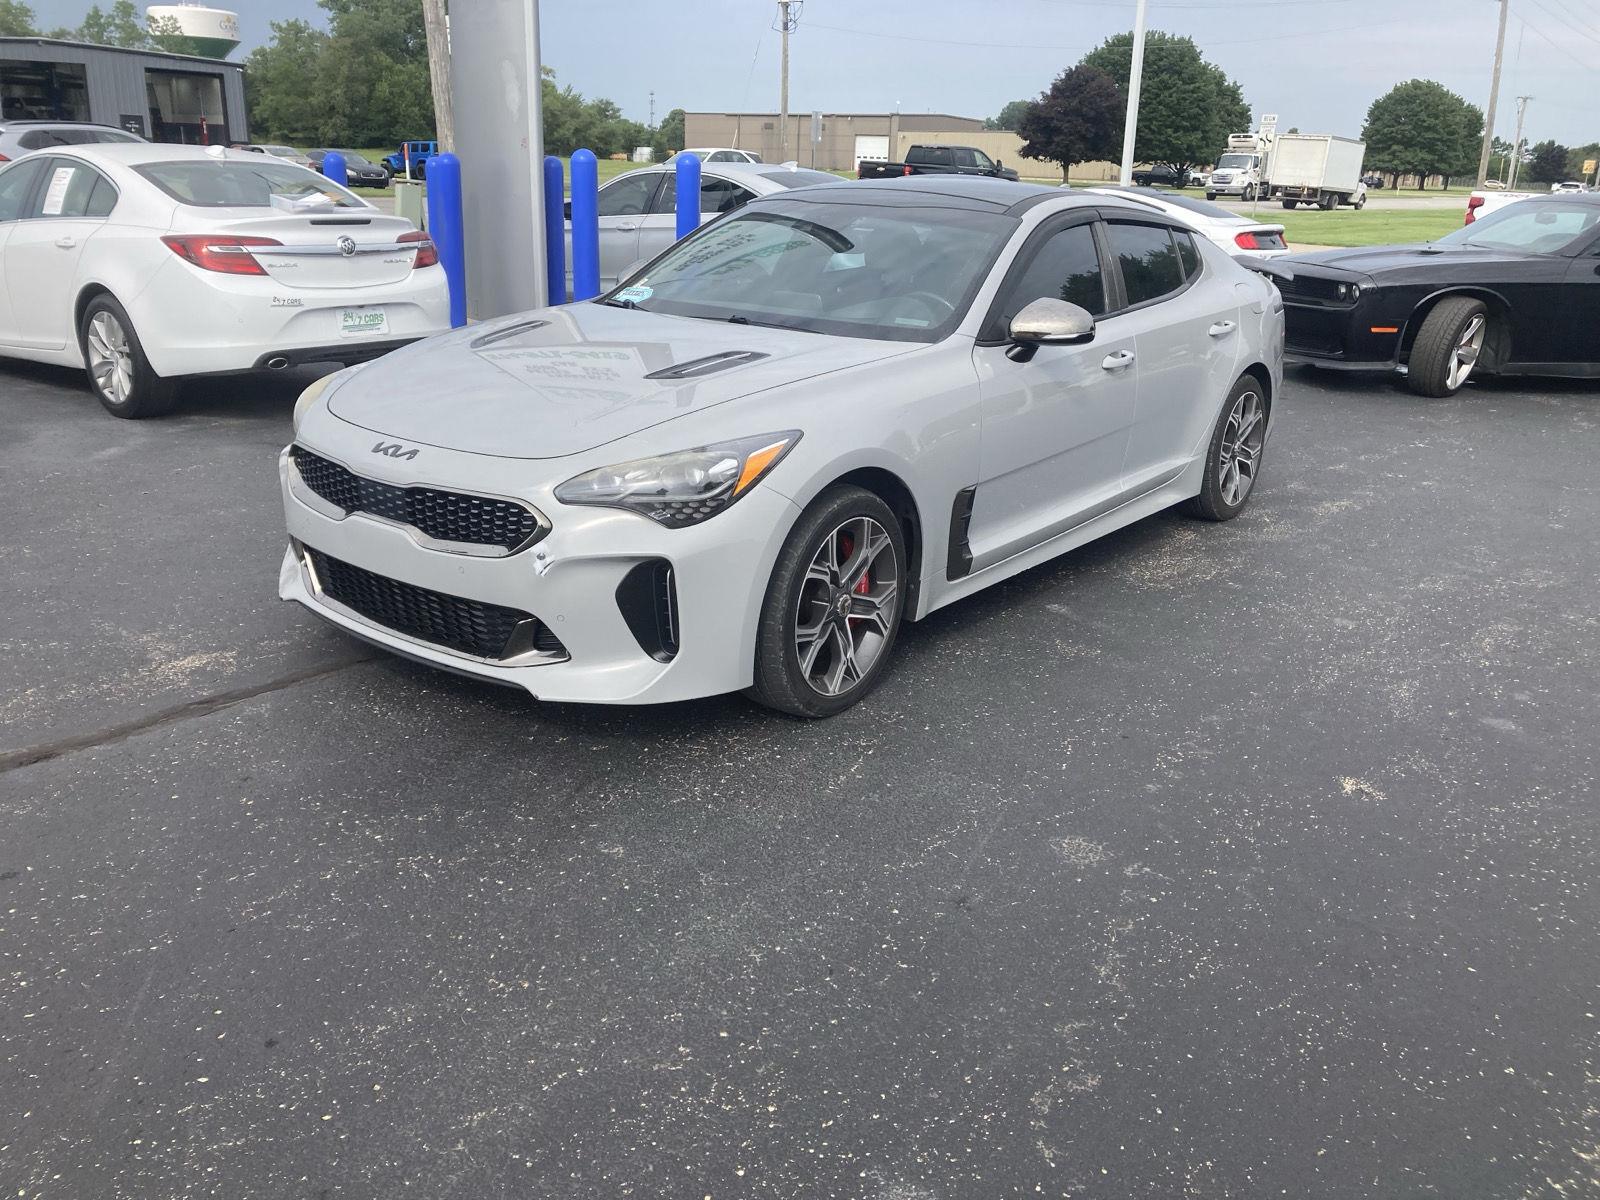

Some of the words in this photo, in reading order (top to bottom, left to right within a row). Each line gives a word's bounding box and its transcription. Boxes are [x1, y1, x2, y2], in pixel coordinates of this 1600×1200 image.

[343, 311, 362, 325] 24/7
[364, 313, 384, 323] CARS
[371, 441, 420, 460] KIA
